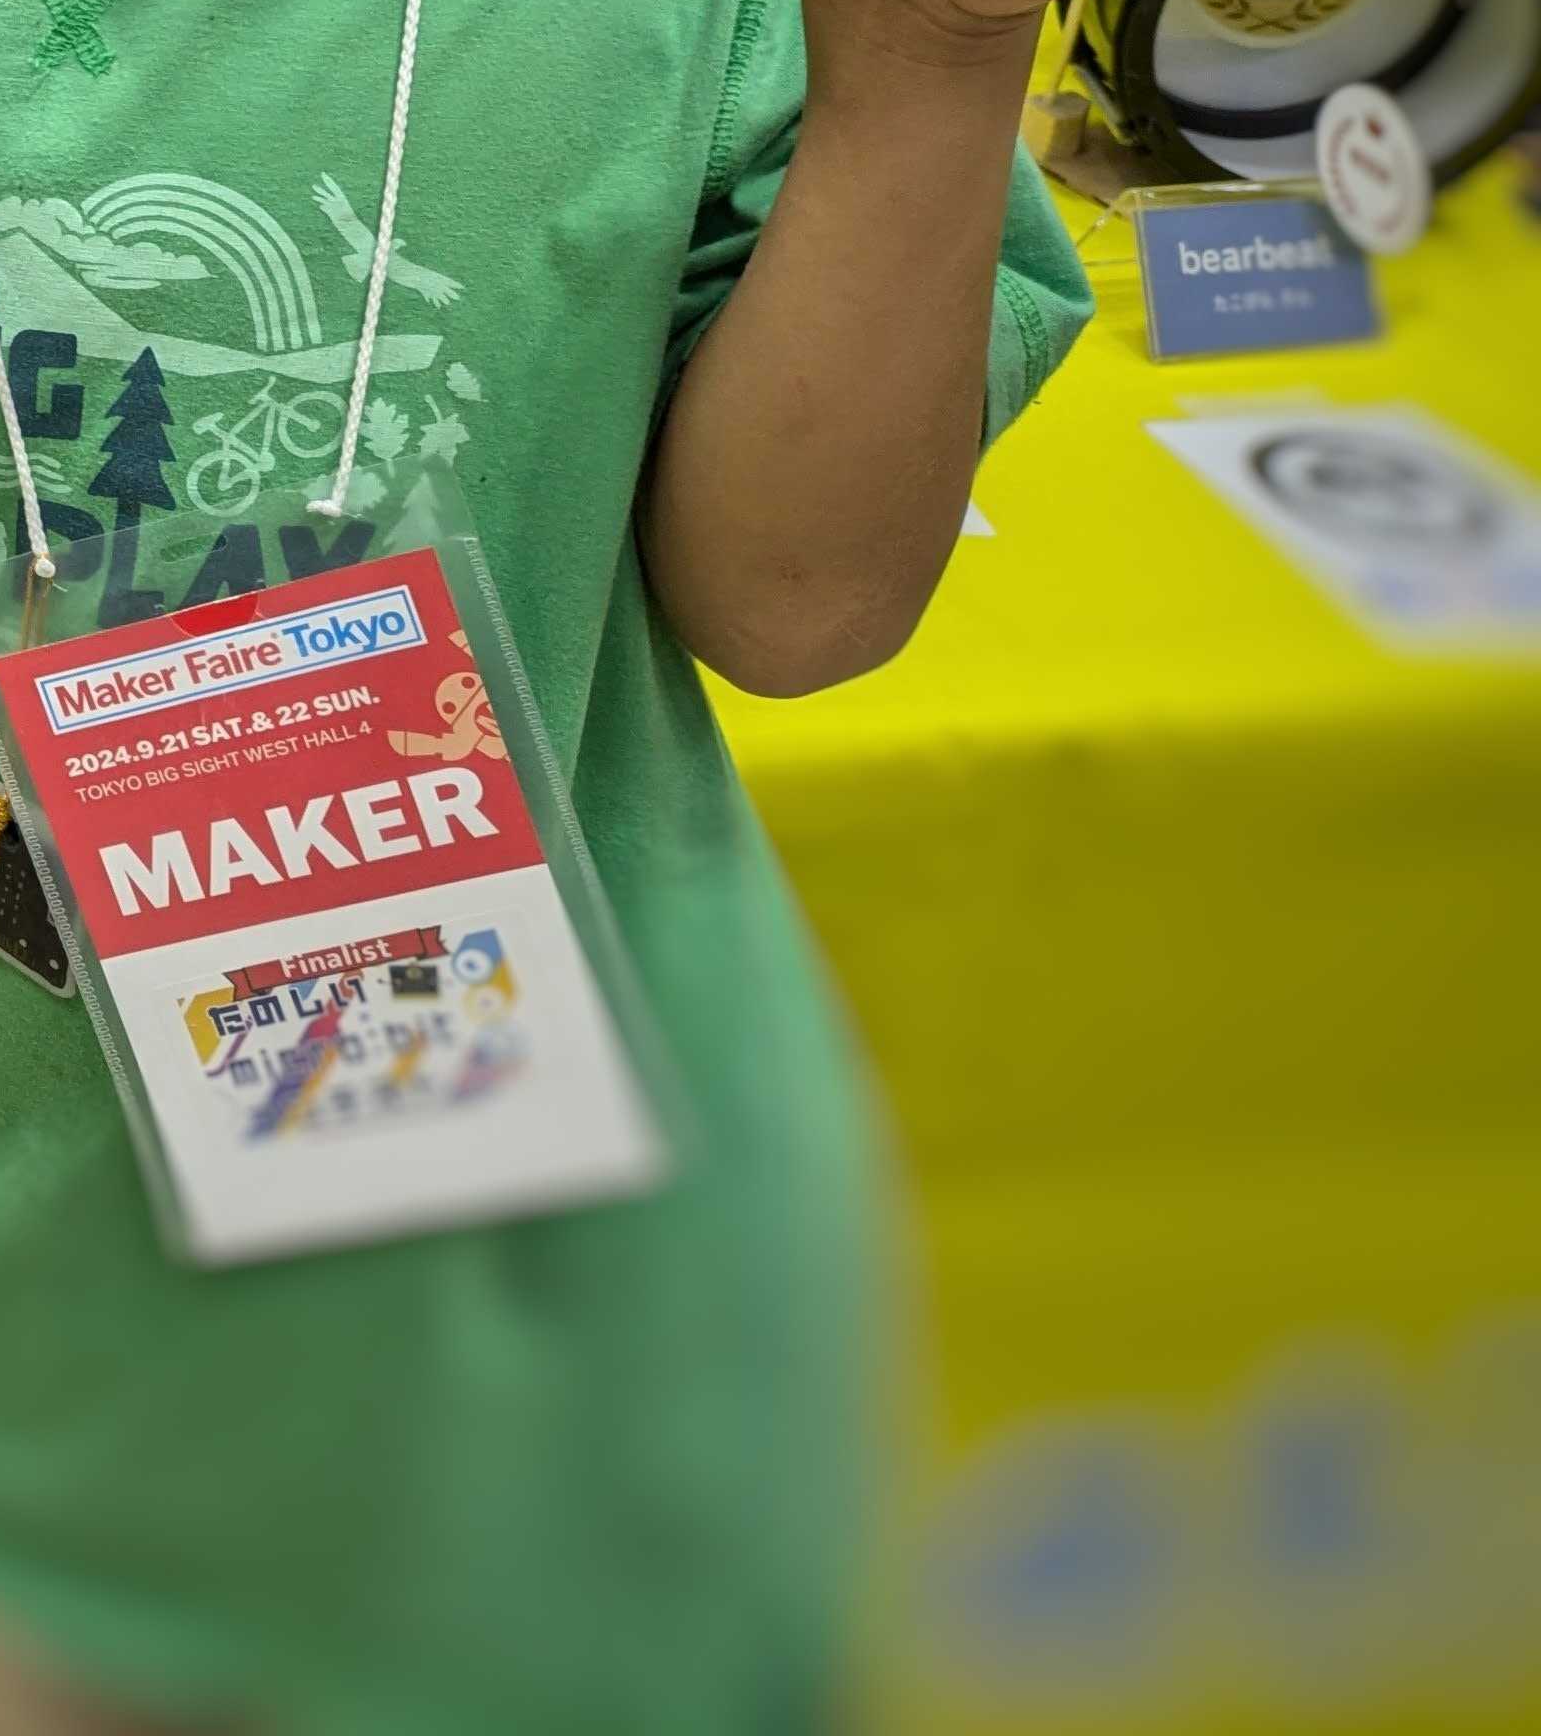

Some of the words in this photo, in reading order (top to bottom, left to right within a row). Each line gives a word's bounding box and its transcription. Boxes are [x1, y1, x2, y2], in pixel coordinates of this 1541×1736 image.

[53, 665, 178, 718] Maker
[183, 640, 283, 685] Faire
[282, 610, 406, 659] Tokyo
[313, 685, 382, 716] SUN.
[75, 775, 143, 804] TOKYO
[144, 766, 181, 788] BIG
[181, 750, 240, 778] SIGHT
[242, 737, 300, 765] WEST
[302, 724, 358, 750] HALL
[358, 720, 374, 737] 4
[98, 765, 501, 918] MAKER
[278, 937, 393, 979] Finalist
